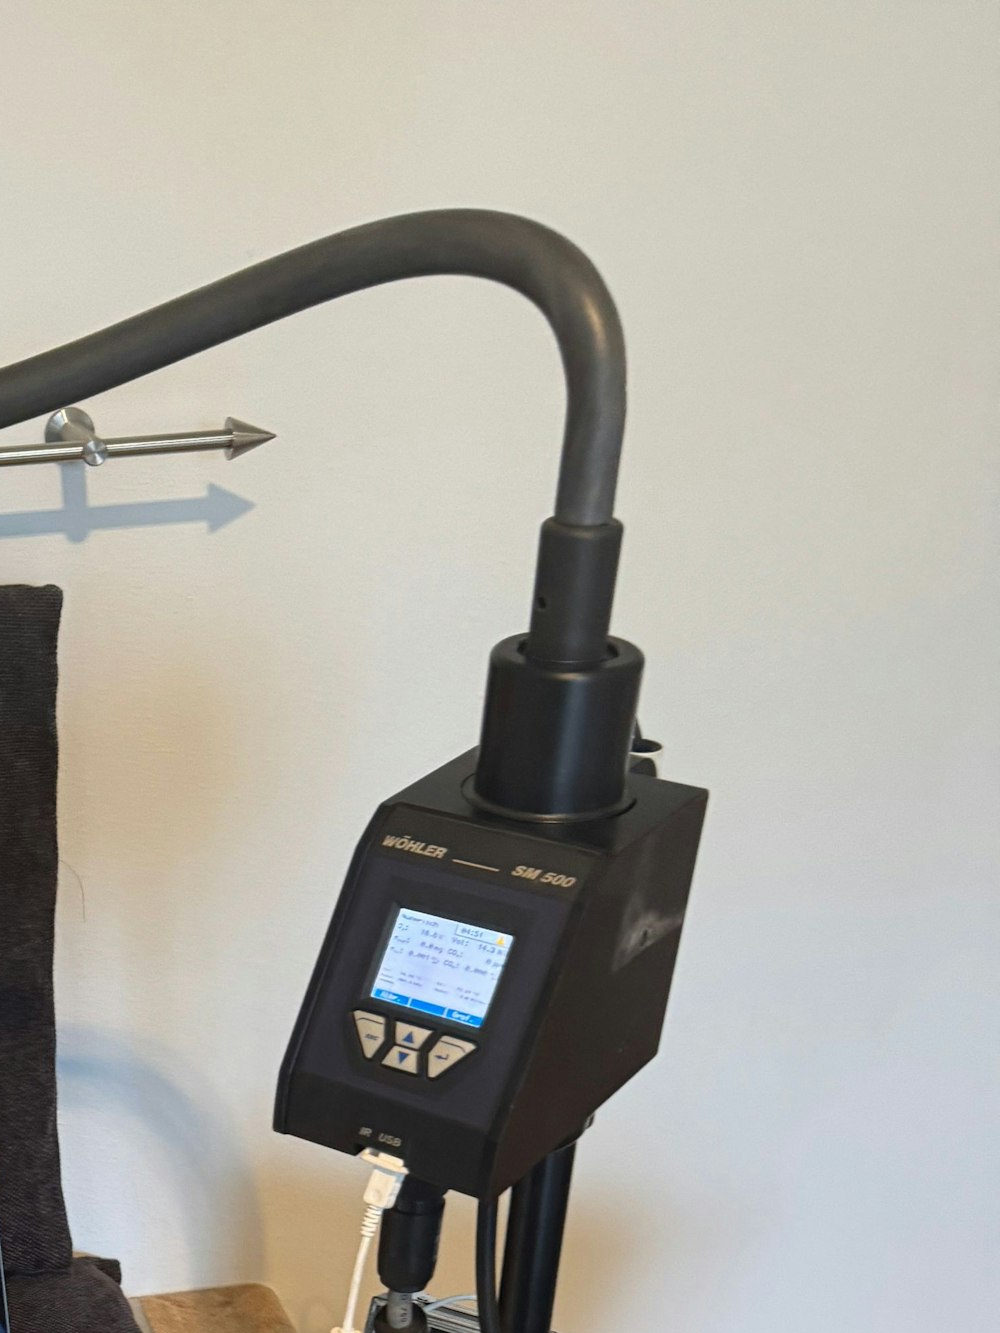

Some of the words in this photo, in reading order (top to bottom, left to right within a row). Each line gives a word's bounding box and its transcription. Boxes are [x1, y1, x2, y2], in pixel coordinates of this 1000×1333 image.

[382, 834, 448, 859] WÖHLER
[511, 865, 542, 880] SM
[540, 872, 577, 888] 500
[378, 1133, 403, 1147] USB
